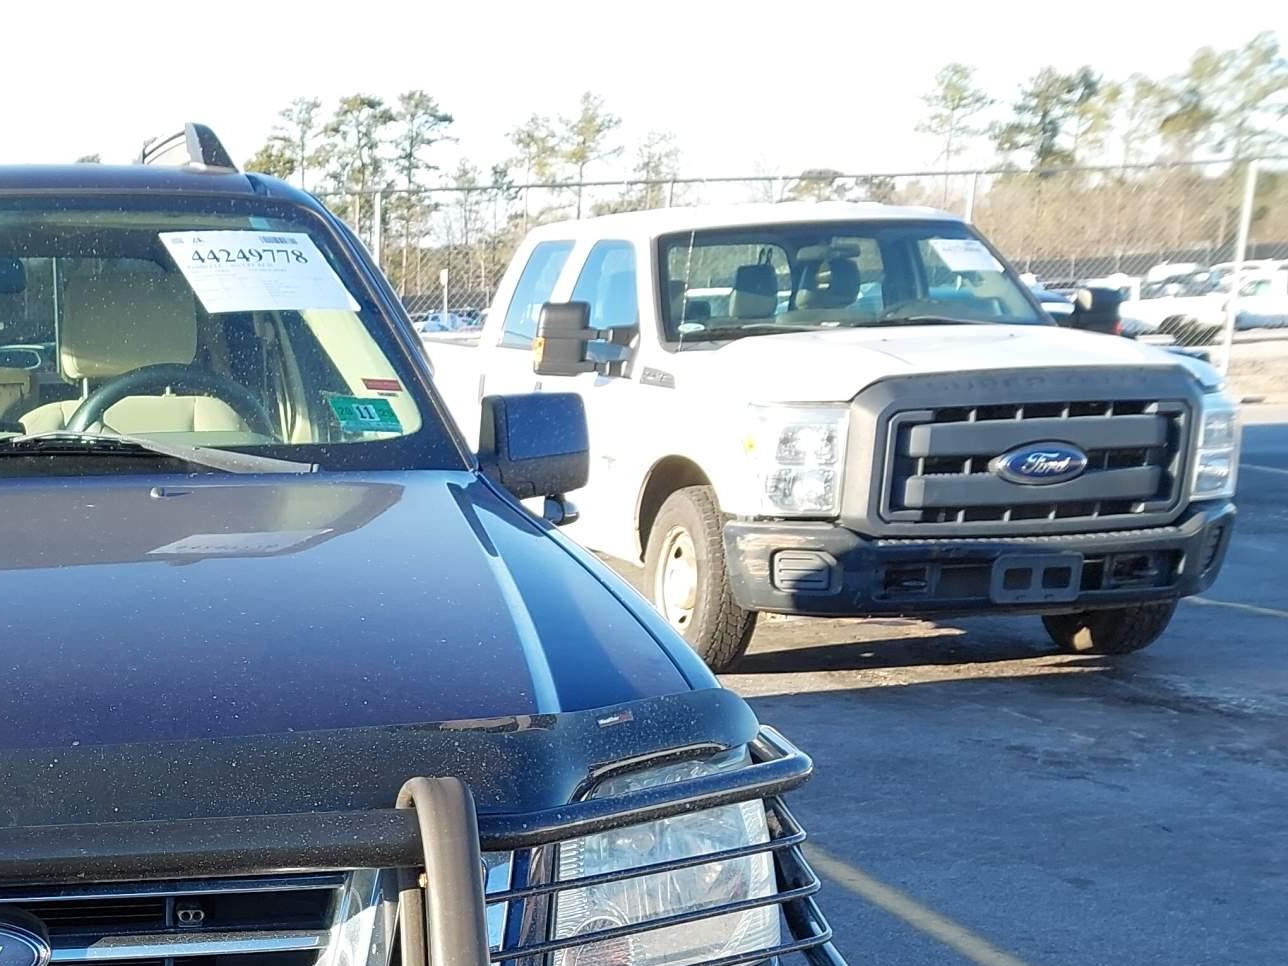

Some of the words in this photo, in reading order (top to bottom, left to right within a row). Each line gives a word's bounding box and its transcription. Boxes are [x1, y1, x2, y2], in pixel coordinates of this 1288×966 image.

[192, 248, 309, 263] 44249778
[355, 405, 375, 420] 11
[1021, 452, 1072, 473] Ford
